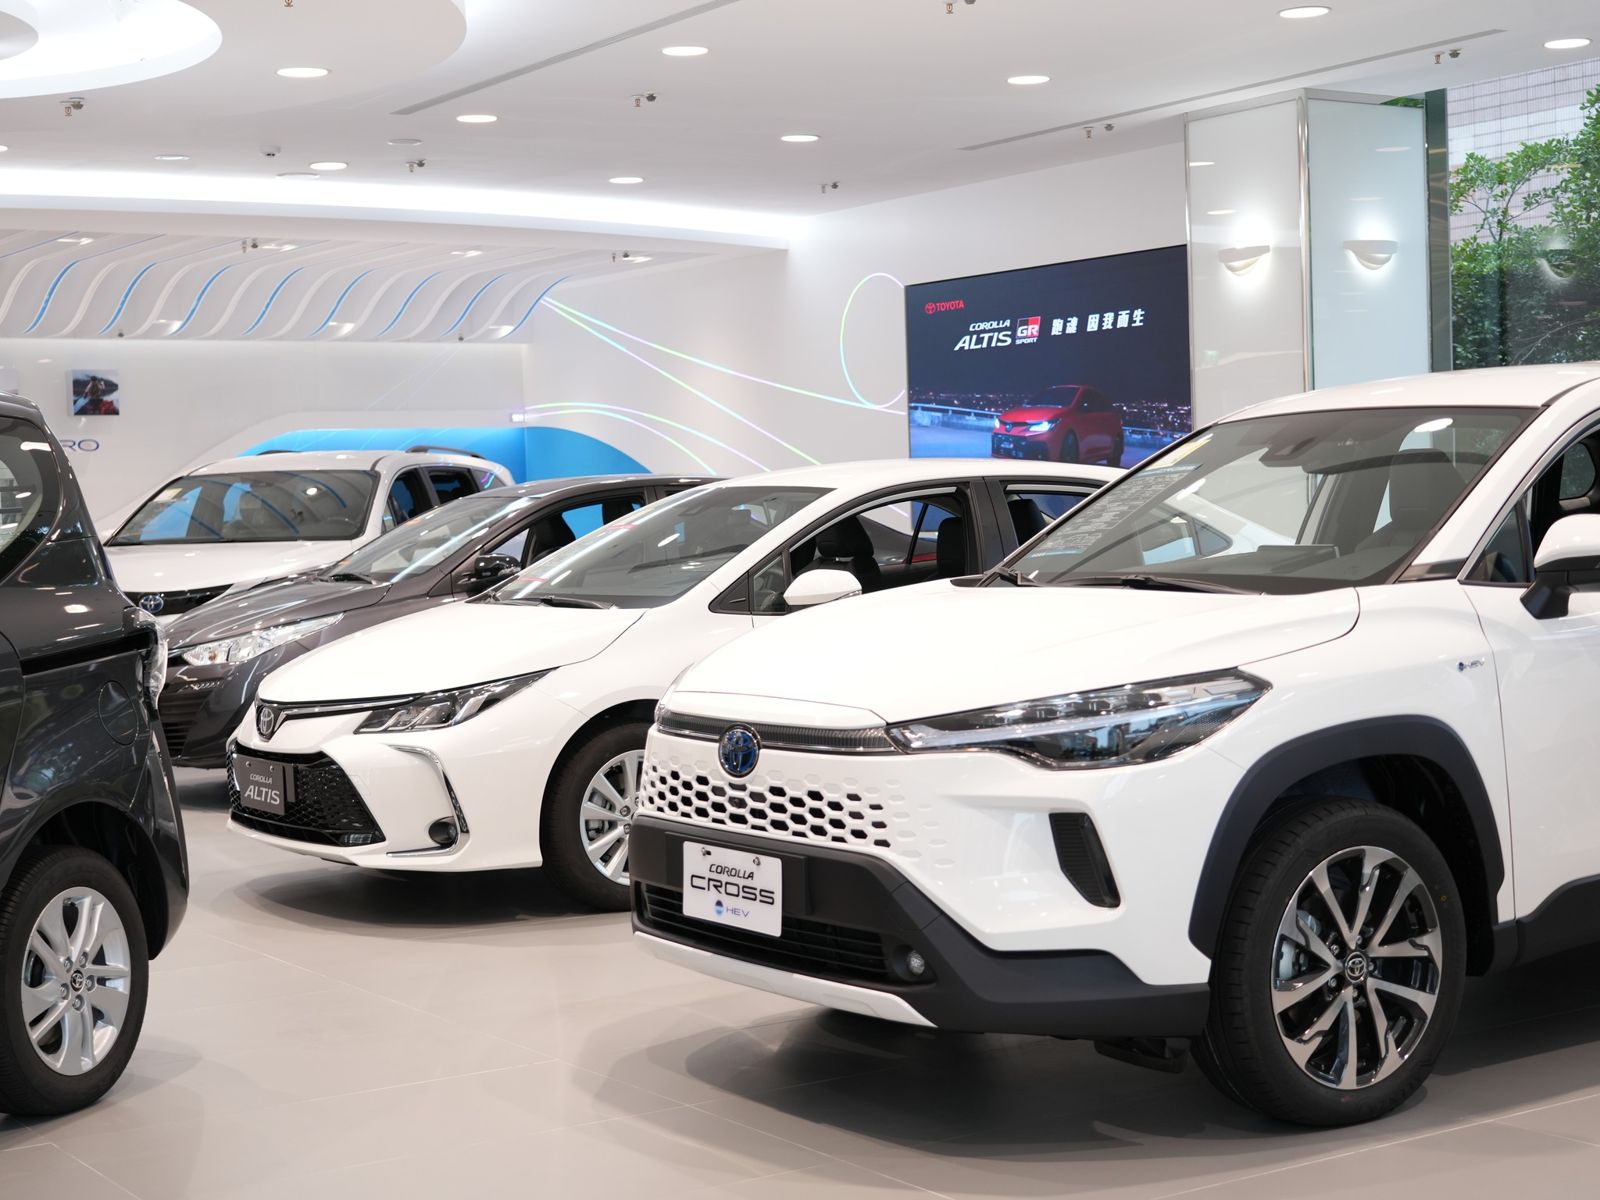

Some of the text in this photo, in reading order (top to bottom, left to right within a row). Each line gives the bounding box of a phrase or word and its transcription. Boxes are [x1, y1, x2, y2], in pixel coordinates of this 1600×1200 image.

[936, 300, 965, 311] TOYOTA
[969, 319, 1011, 331] COROLLA
[1086, 308, 1145, 332] 因我而生
[1017, 325, 1039, 337] GR
[953, 331, 1012, 351] ALTIS
[1015, 337, 1038, 345] SPORT
[60, 439, 100, 451] RO
[250, 773, 273, 785] COROLLA
[244, 785, 280, 805] ALTIS
[709, 863, 754, 880] COROLLA
[690, 874, 775, 905] CROSS
[726, 906, 750, 918] HEV
